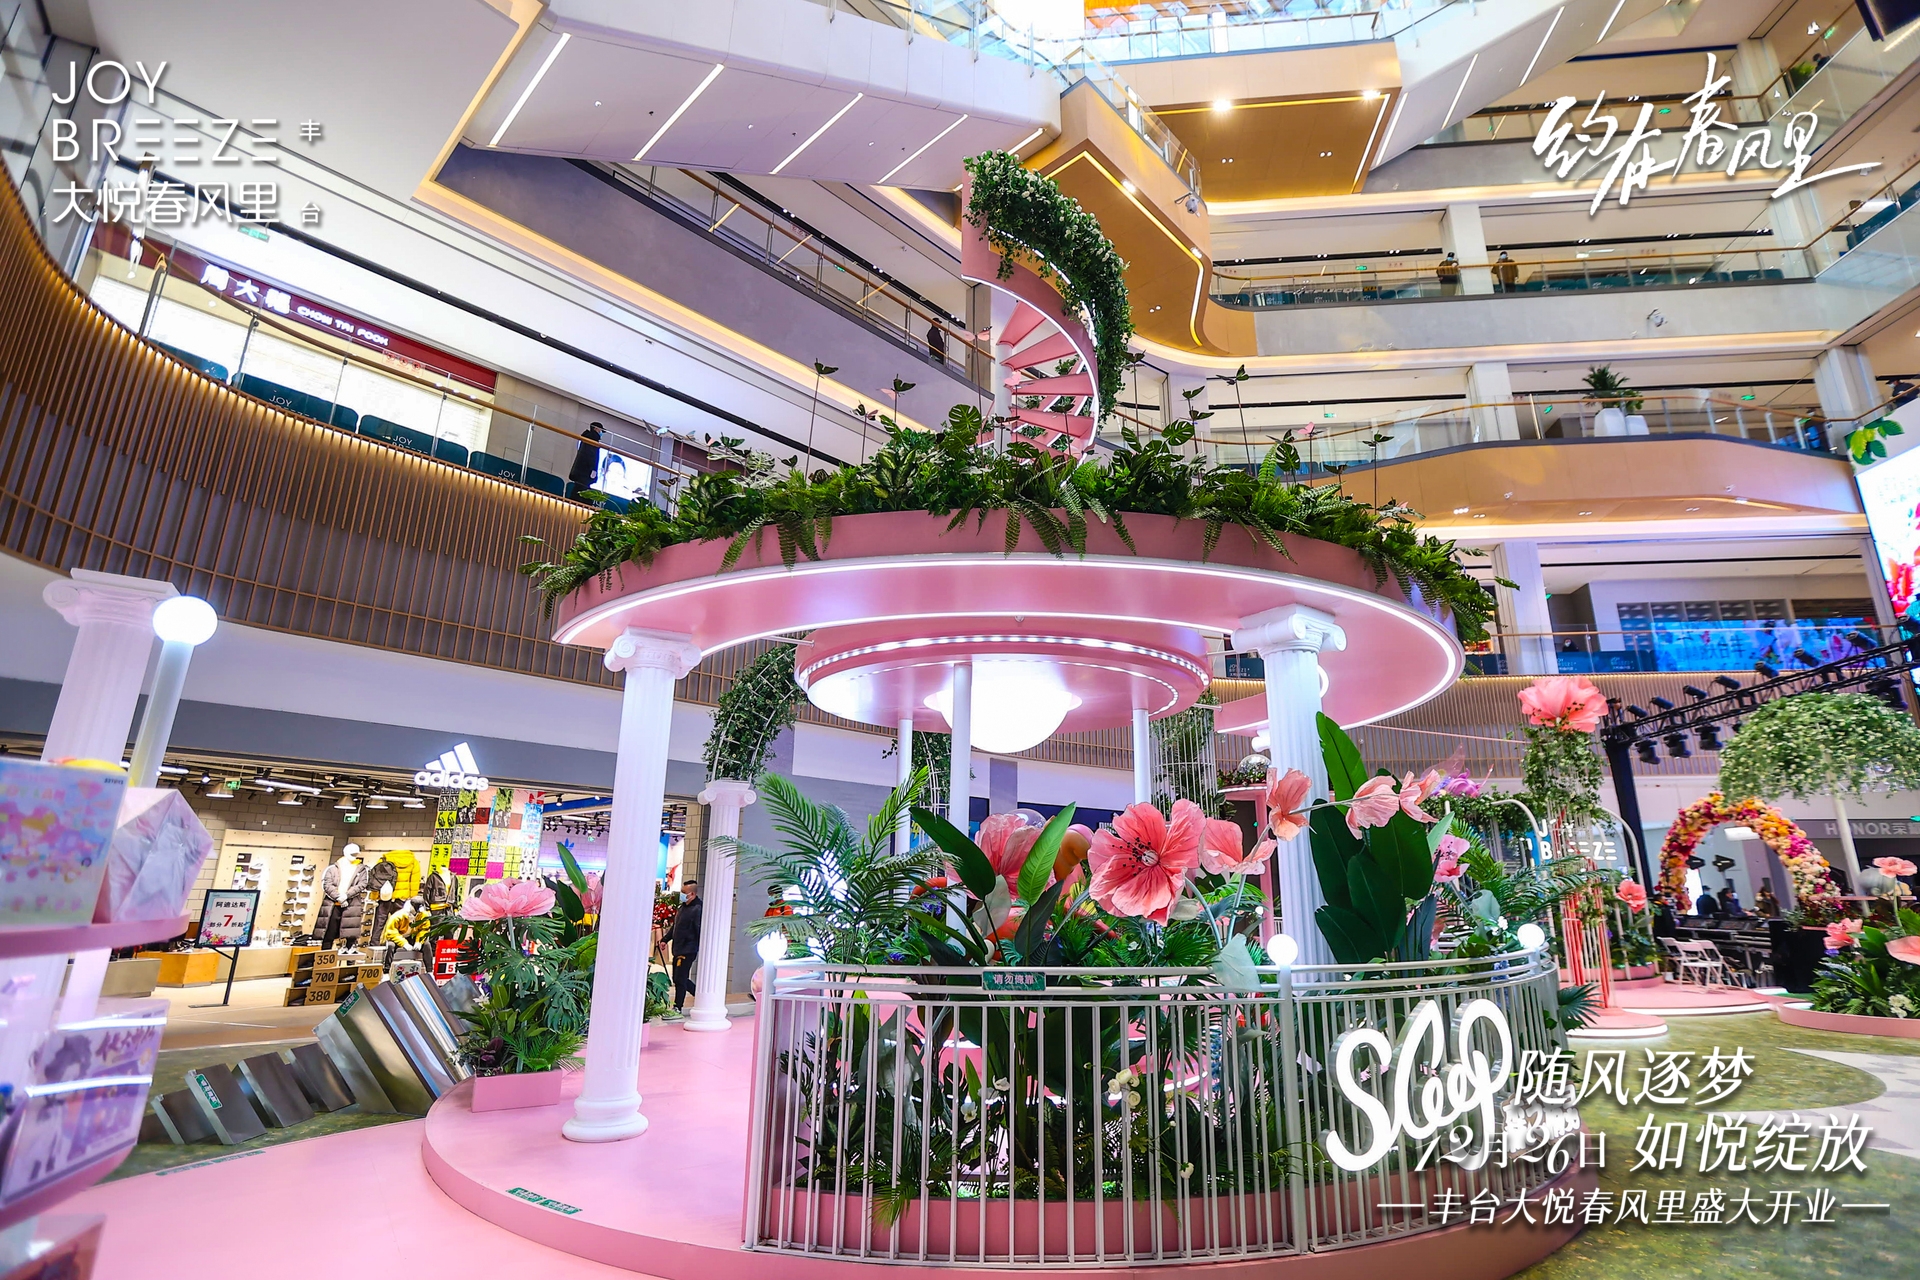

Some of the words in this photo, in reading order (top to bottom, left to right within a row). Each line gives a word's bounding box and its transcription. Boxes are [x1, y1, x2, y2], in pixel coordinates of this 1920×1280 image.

[269, 395, 293, 407] JOY
[392, 435, 413, 445] JOY
[498, 469, 516, 479] JOY
[413, 769, 490, 791] adidas
[1540, 841, 1618, 861] BEEZE
[316, 954, 336, 965] 350
[315, 972, 335, 983] 700
[360, 968, 380, 979] 700
[308, 990, 331, 1002] 380
